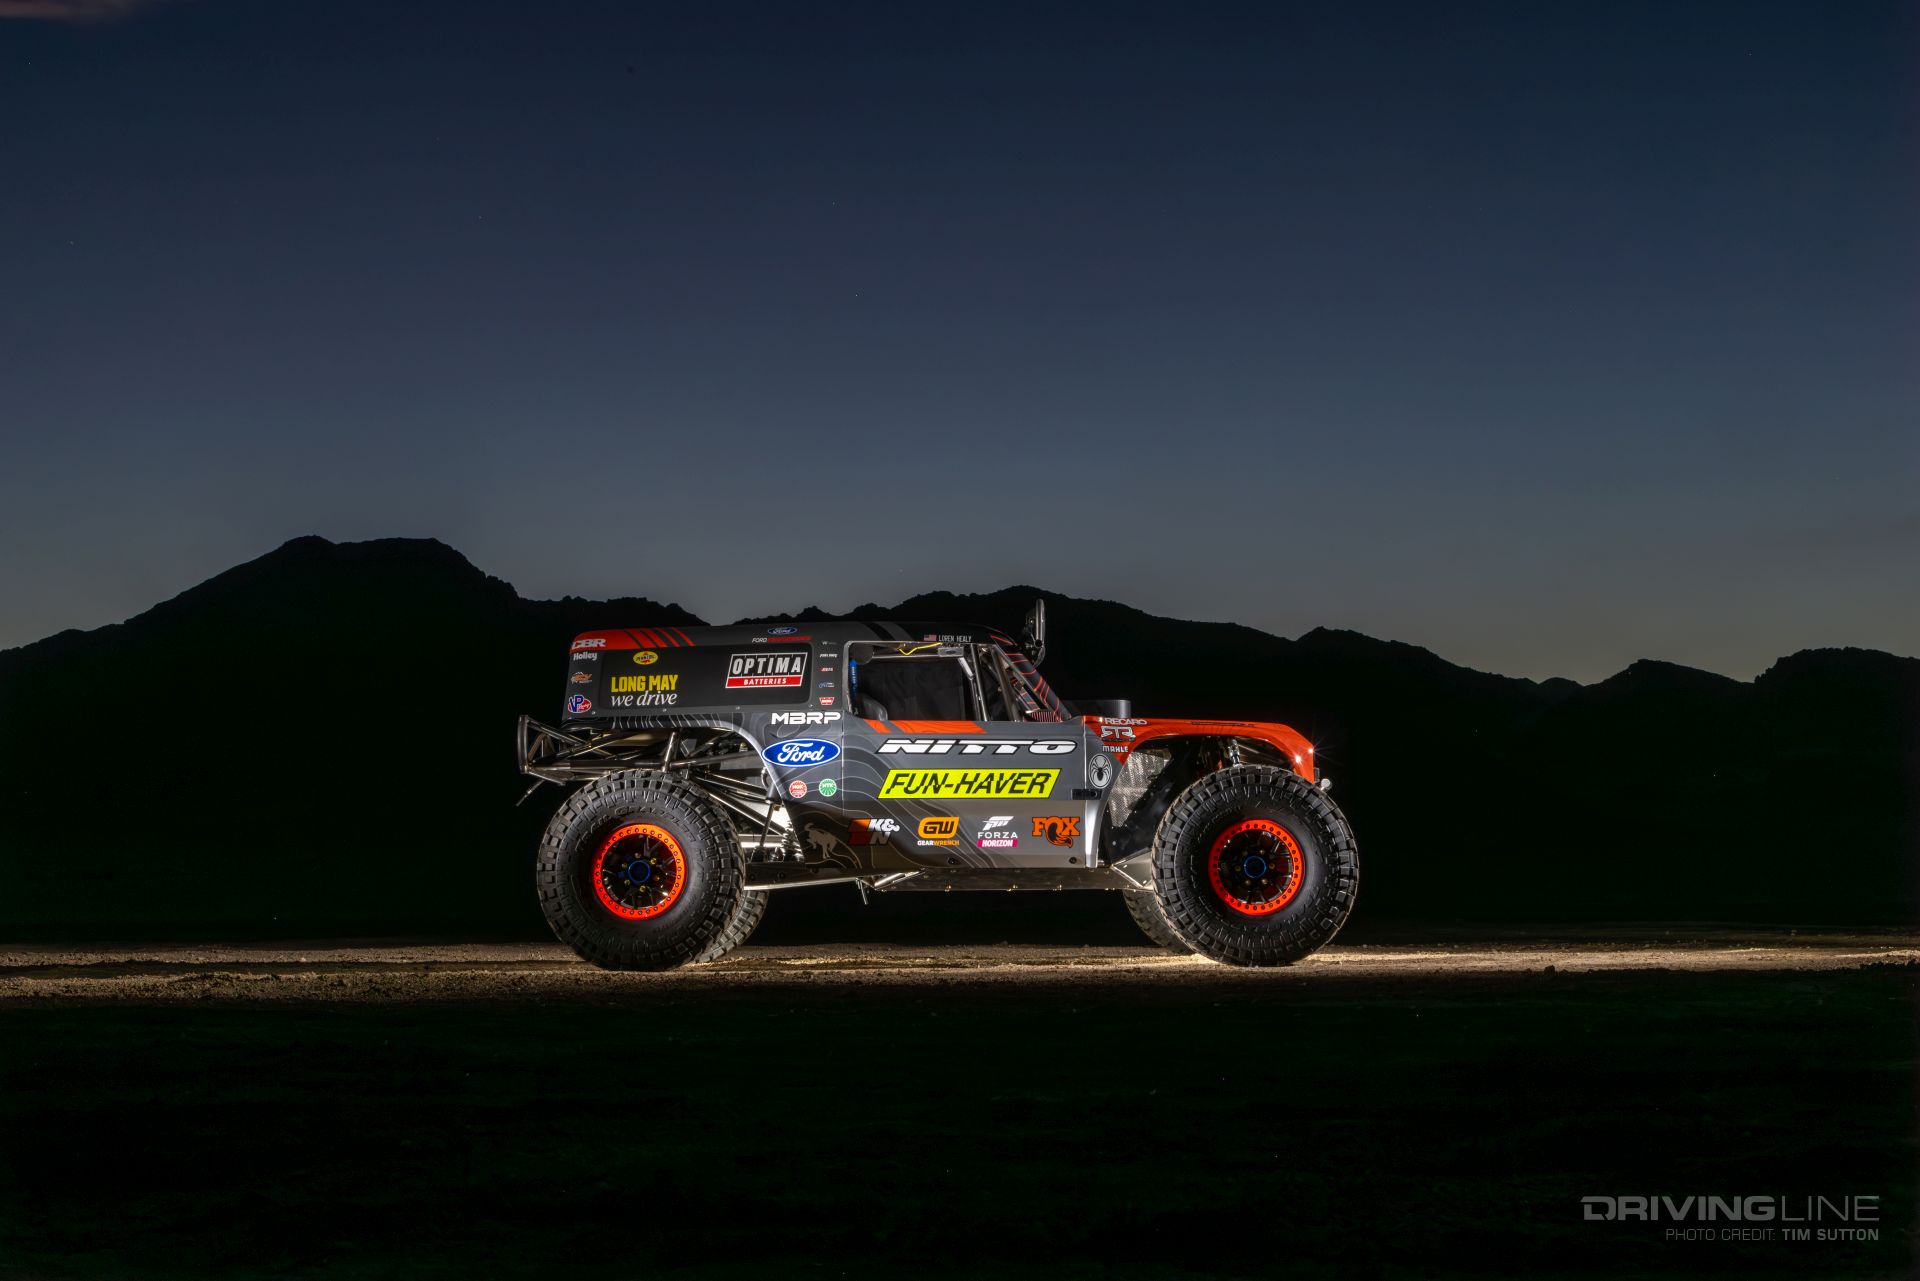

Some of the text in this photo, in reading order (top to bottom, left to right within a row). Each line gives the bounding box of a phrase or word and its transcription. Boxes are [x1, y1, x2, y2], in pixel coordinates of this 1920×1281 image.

[938, 634, 972, 643] LOREN HEALY
[573, 651, 598, 661] Holley
[732, 656, 802, 675] OPTIMA
[611, 675, 646, 693] LONG
[648, 674, 679, 692] MAY
[743, 678, 787, 686] BATTERIES
[568, 694, 585, 713] VP
[611, 690, 678, 707] we drive
[770, 711, 841, 725] MBRP
[1104, 717, 1148, 726] RECARO
[777, 742, 826, 763] Ford
[875, 737, 1078, 756] NITTO
[1102, 745, 1129, 753] MAHLE
[885, 772, 1052, 795] FUN-HAVER
[923, 820, 956, 835] GW
[1031, 816, 1081, 840] FOX
[977, 831, 1018, 839] FORZA
[917, 839, 960, 847] GEARWRENCH
[981, 840, 1014, 848] HORIZON
